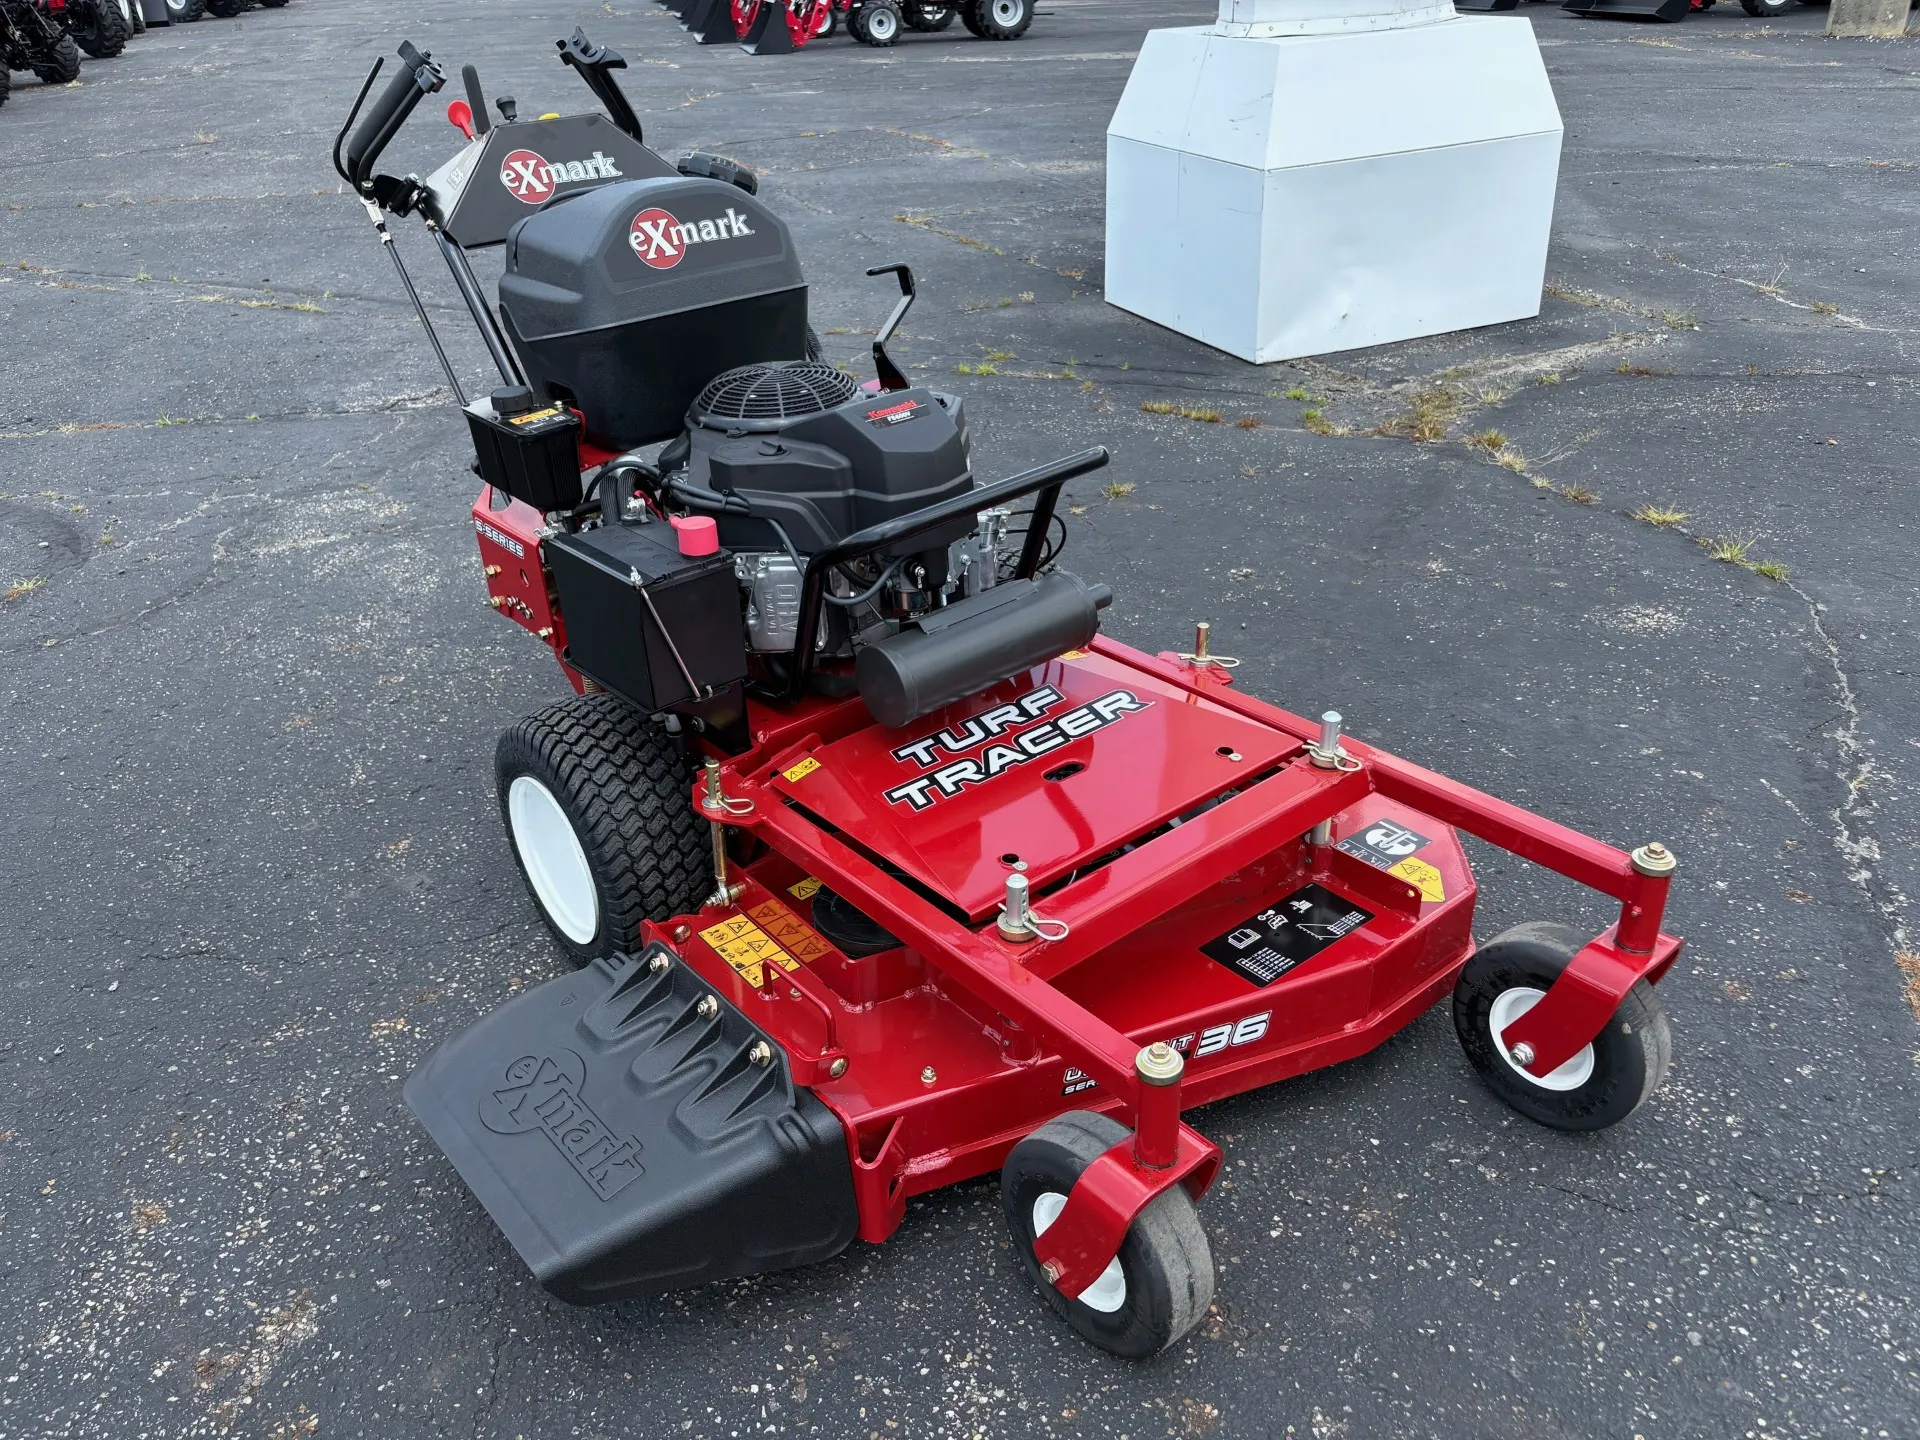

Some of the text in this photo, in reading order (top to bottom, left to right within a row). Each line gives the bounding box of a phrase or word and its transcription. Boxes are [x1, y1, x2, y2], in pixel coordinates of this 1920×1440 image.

[500, 152, 623, 196] eXmark
[629, 208, 756, 259] eXmark
[867, 400, 917, 419] Kawasaki
[475, 517, 524, 559] S-SERIES
[884, 690, 1149, 810] TRACER
[892, 685, 1064, 768] TURF
[492, 1055, 635, 1192] eXmark
